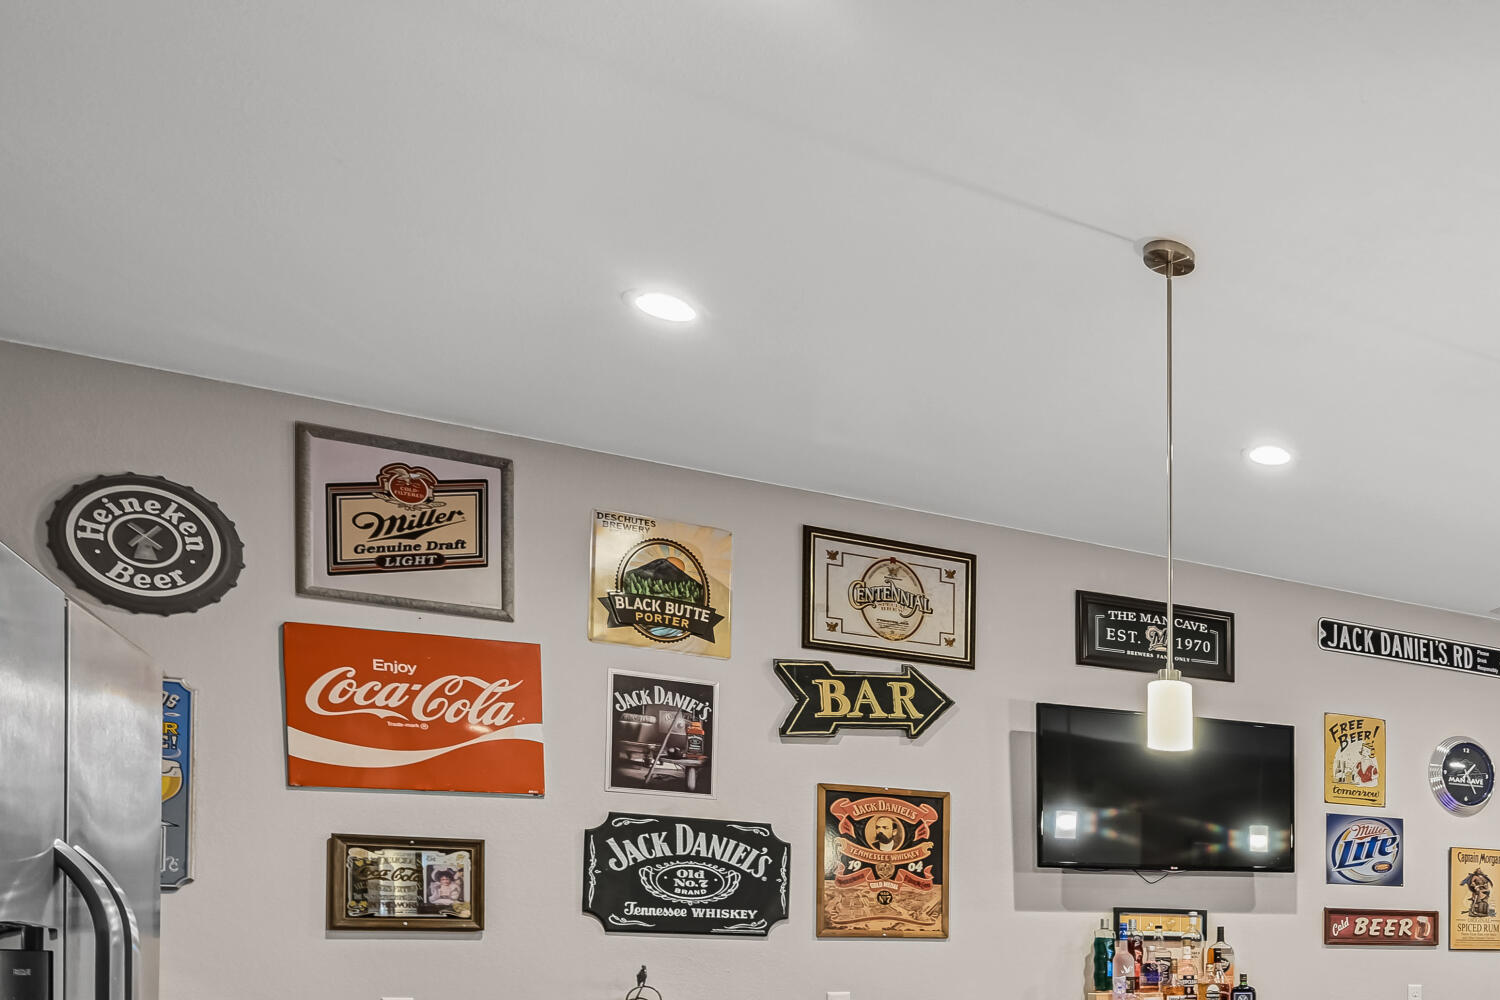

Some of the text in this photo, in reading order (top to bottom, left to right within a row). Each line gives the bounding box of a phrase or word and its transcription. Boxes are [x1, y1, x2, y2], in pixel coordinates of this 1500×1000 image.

[77, 497, 204, 552] Heineken
[352, 508, 465, 540] Miller
[596, 511, 656, 528] DESCHUTES
[602, 520, 650, 534] BREWERY
[353, 539, 467, 555] Genuine Draft
[384, 555, 437, 567] LIGHT
[105, 560, 186, 589] Beer
[848, 579, 933, 618] CENTENNIAL
[614, 596, 711, 622] BLACK BUTTE
[635, 612, 690, 628] PORTER
[1108, 610, 1208, 633] THE MAN CAVE
[1106, 627, 1141, 644] EST.
[1175, 637, 1211, 653] 1970
[1327, 624, 1473, 669] JACK DANIEL'S RD
[372, 658, 417, 675] Enjoy
[305, 666, 523, 726] Coca-Cola
[614, 689, 653, 712] JACK
[812, 679, 924, 719] BAR
[1329, 719, 1364, 743] FREE
[1338, 725, 1380, 753] BEER!
[1332, 785, 1380, 798] tomorrow
[853, 799, 918, 820] JACK DANIEL'S
[1350, 824, 1389, 838] Miller
[605, 823, 772, 878] JACK DANIEL'S
[849, 847, 920, 861] TENNESSEE WHISKEY
[1334, 835, 1398, 869] Lite
[1457, 852, 1479, 864] Captain
[676, 869, 705, 879] Old
[847, 860, 862, 872] 19
[907, 861, 923, 872] 04
[674, 888, 707, 896] BRAND
[624, 901, 758, 920] Tennessee WHISKEY
[1332, 916, 1413, 936] Cold BEER
[1457, 923, 1500, 933] SPICED RUM
